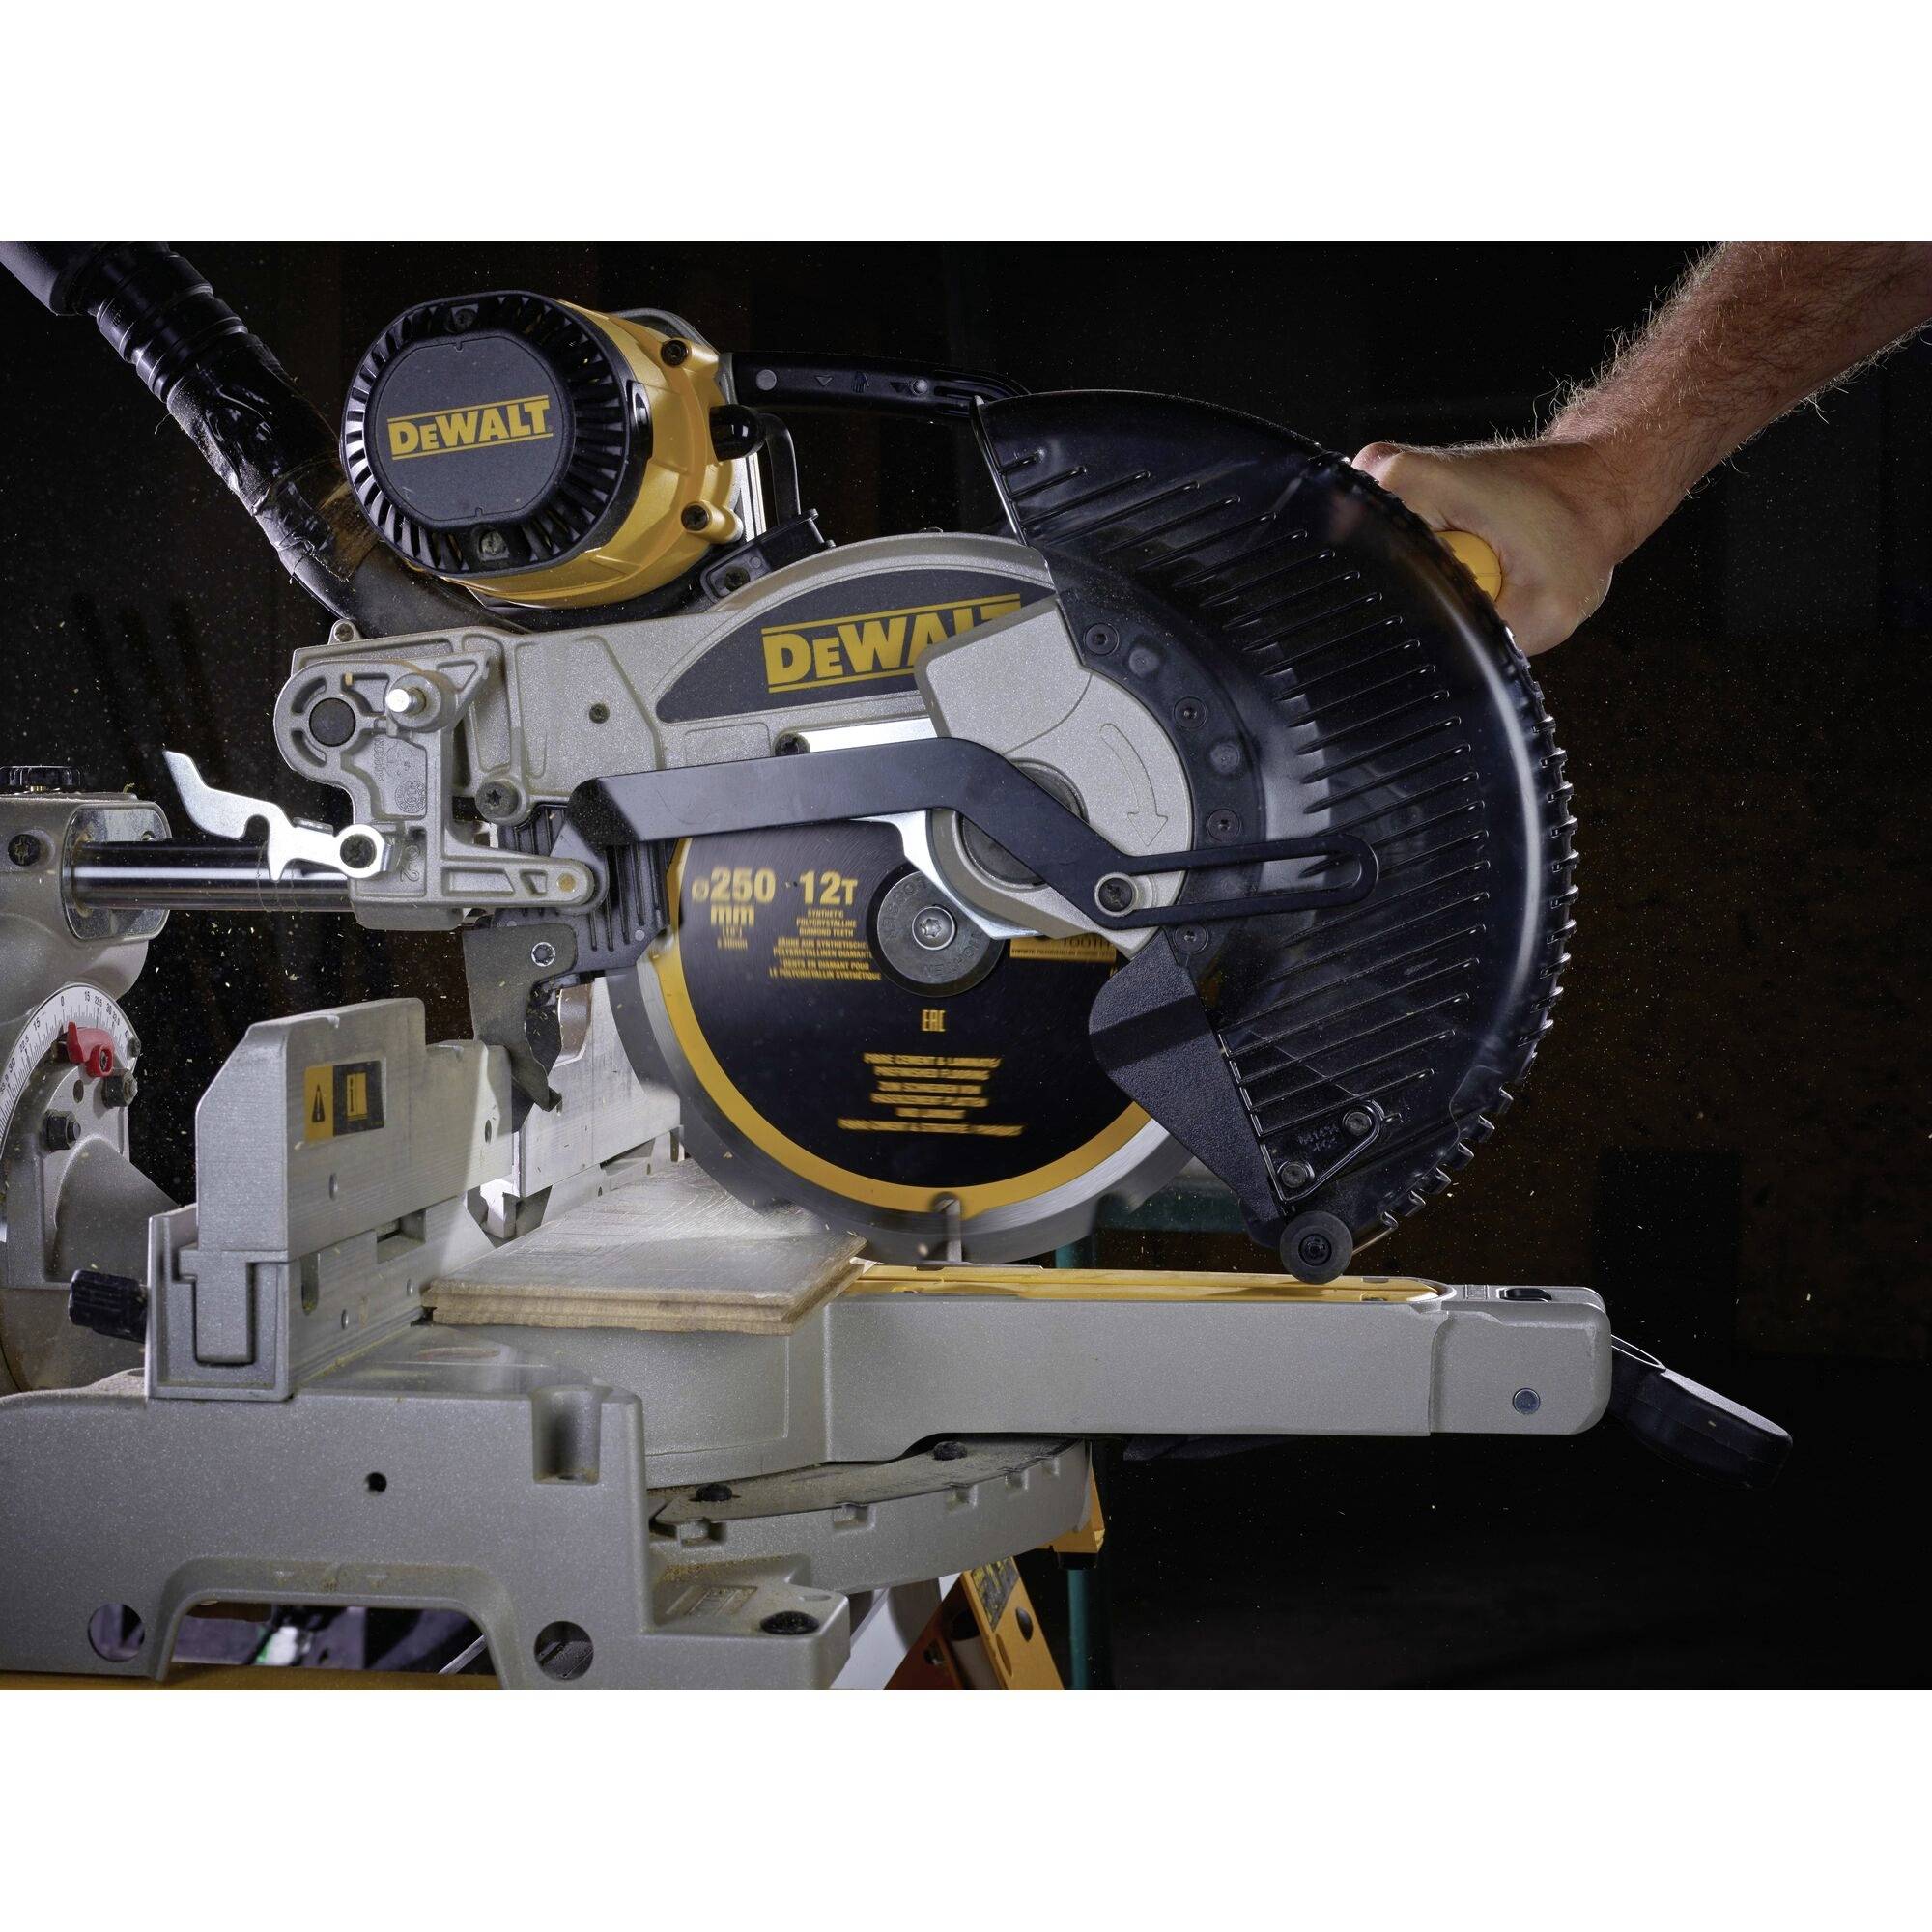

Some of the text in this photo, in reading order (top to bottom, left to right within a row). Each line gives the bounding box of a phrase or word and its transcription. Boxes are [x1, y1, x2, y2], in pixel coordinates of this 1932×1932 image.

[710, 904, 755, 926] mm
[60, 995, 65, 1007] 0
[84, 990, 91, 1002] 15
[33, 1017, 41, 1031] 15
